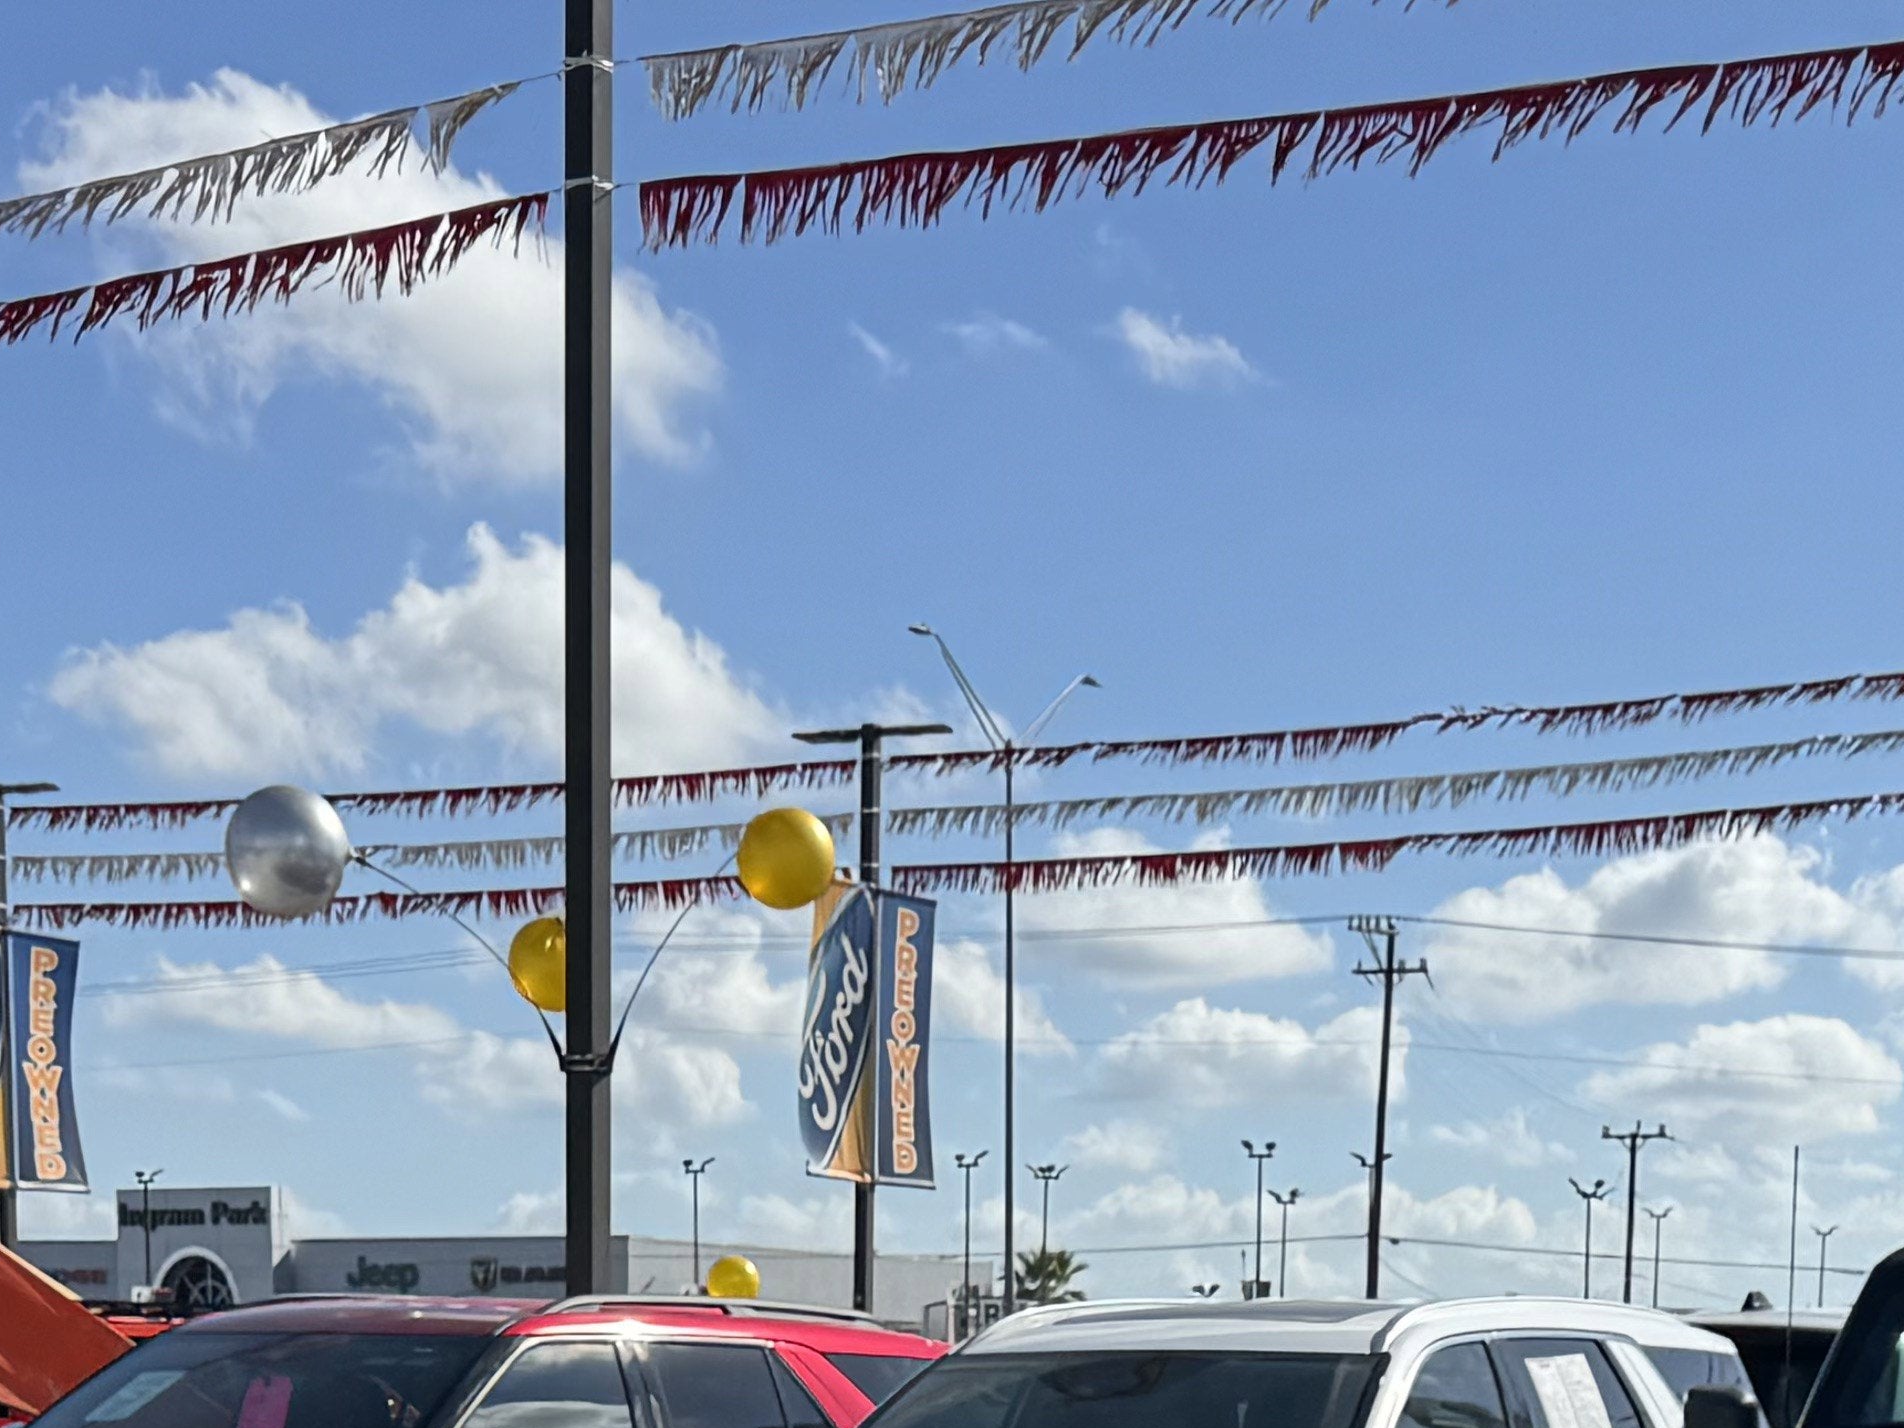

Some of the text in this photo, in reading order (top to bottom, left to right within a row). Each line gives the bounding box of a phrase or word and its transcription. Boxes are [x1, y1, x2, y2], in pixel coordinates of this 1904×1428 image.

[22, 946, 67, 1180] PREOWNED
[799, 932, 868, 1131] Ford
[886, 908, 921, 1174] PREOWNED
[346, 1255, 420, 1294] Jeep
